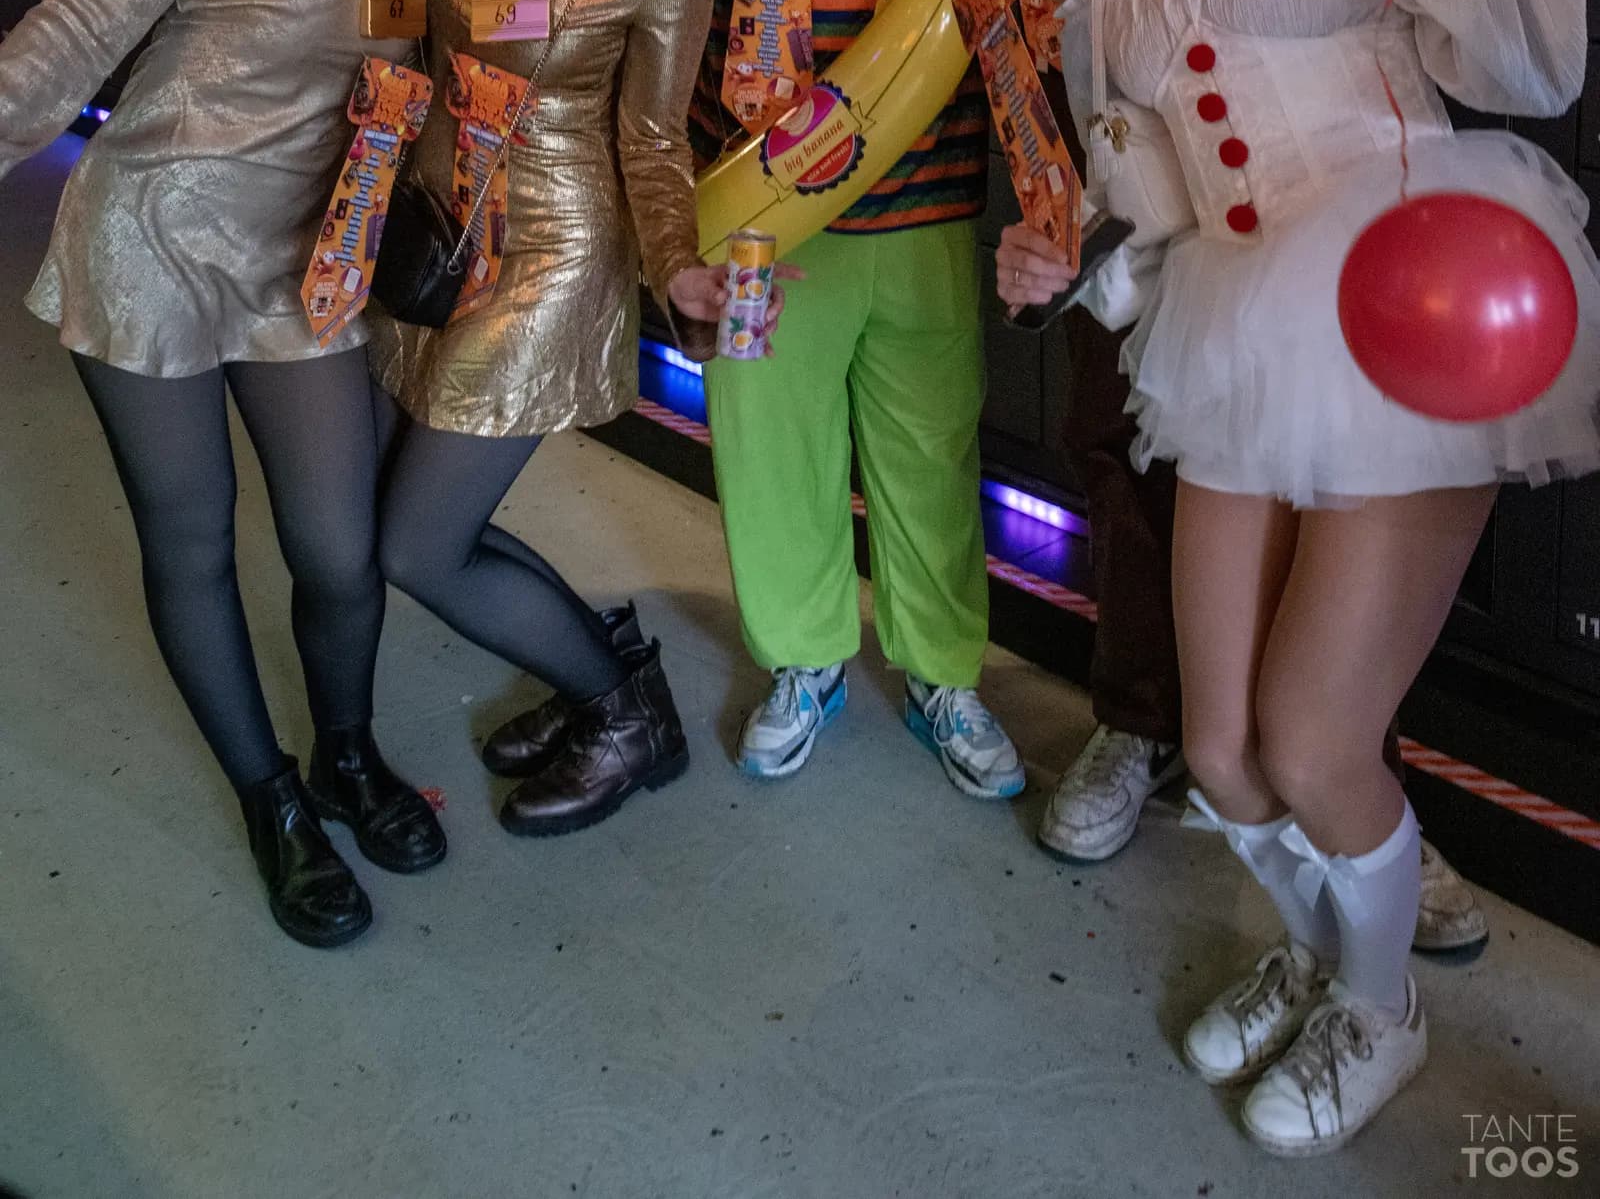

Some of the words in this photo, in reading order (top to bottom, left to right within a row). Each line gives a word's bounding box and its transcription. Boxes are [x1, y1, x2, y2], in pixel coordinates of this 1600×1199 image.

[389, 0, 404, 19] 67
[494, 3, 516, 25] 69
[783, 153, 804, 174] big
[803, 119, 845, 158] banana
